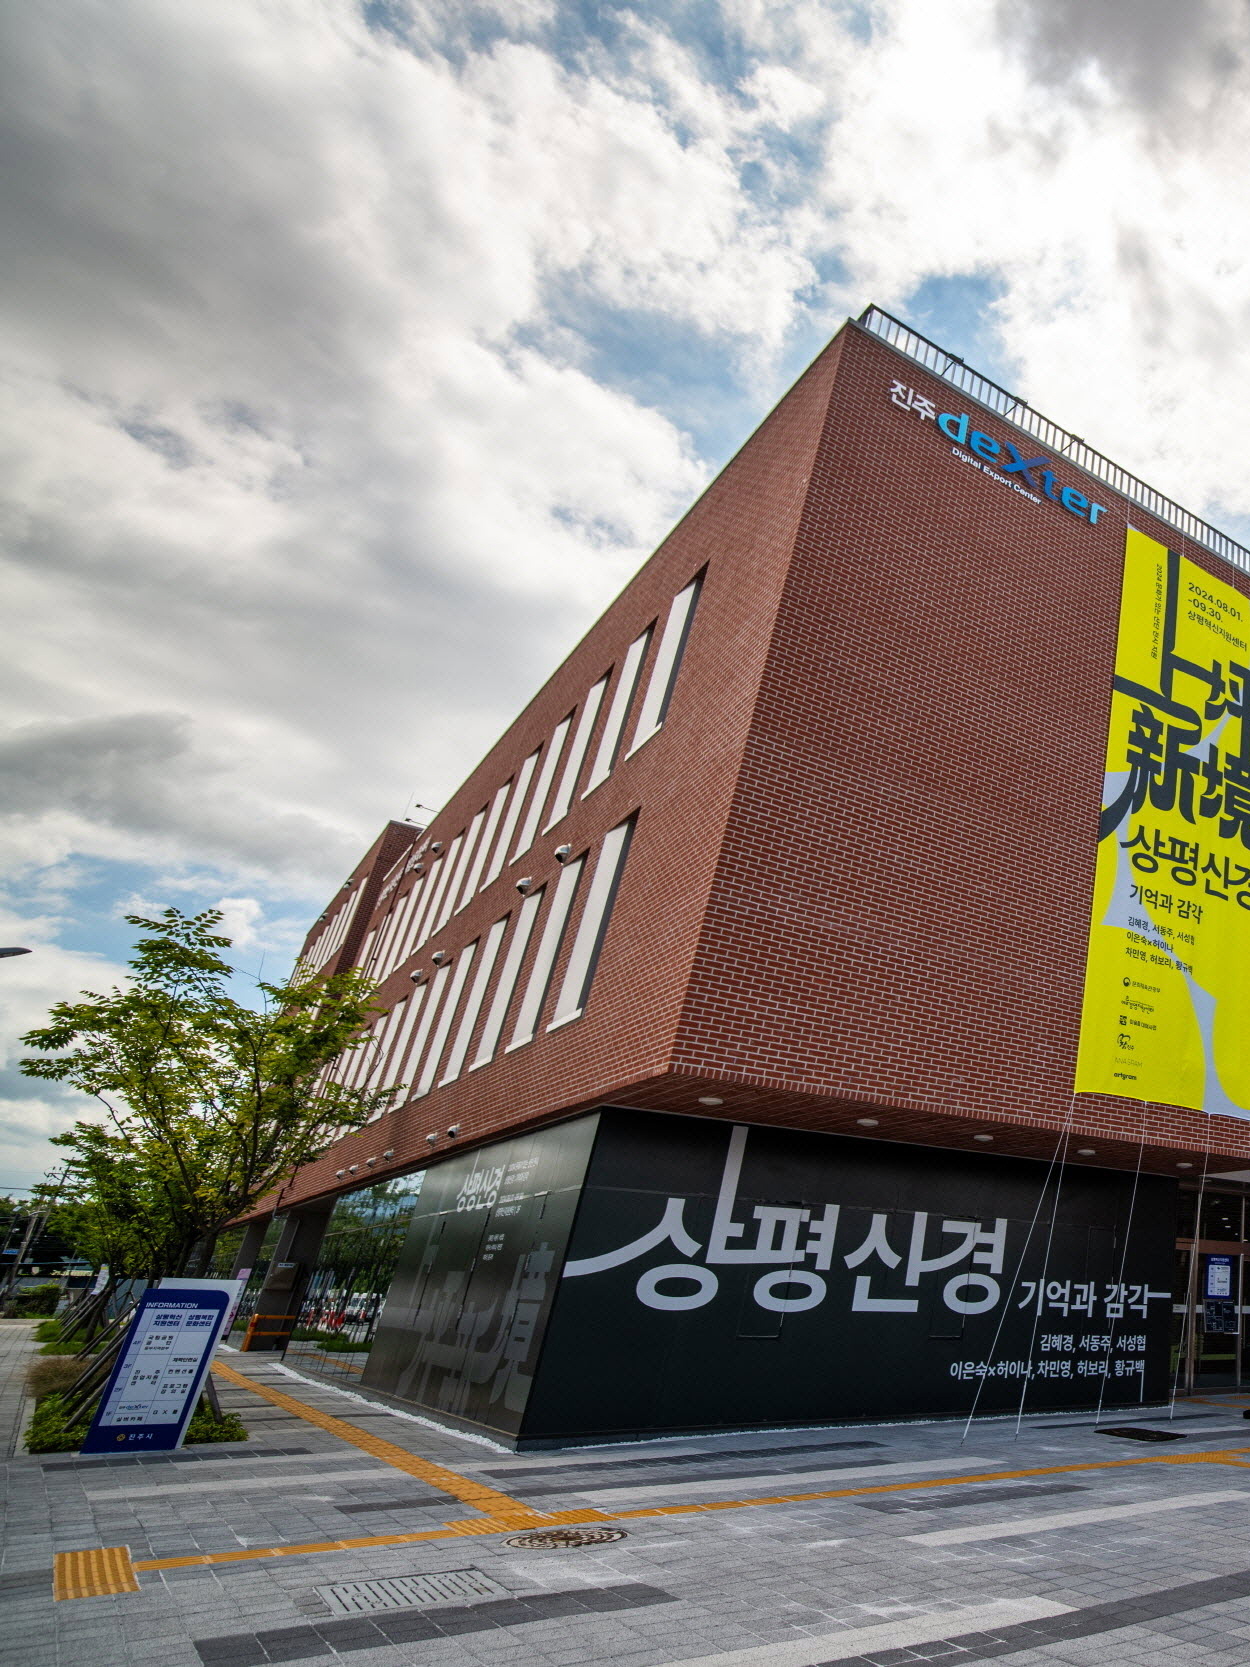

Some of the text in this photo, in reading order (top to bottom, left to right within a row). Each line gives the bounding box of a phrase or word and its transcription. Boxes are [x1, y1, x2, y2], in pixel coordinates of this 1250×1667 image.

[952, 446, 1042, 505] Digital Export Center
[1187, 598, 1224, 623] -09.30.
[1188, 582, 1243, 623] 2024.08.01.
[1187, 610, 1247, 652] 상평혁신지원센터
[1129, 884, 1203, 925] 기억과 감각
[1128, 916, 1150, 932] 김혜경,
[1152, 924, 1175, 940] 서동주,
[1150, 954, 1174, 970] 허보리,
[563, 1126, 1008, 1313] 상평신경
[1018, 1278, 1097, 1318] 기억과
[1104, 1283, 1171, 1319] 감각
[1040, 1334, 1146, 1353] 김혜경, 서동주, 서성협
[1037, 1360, 1073, 1379] 차민영,
[1077, 1359, 1111, 1378] 허보리,
[128, 1433, 154, 1441] 진주시
